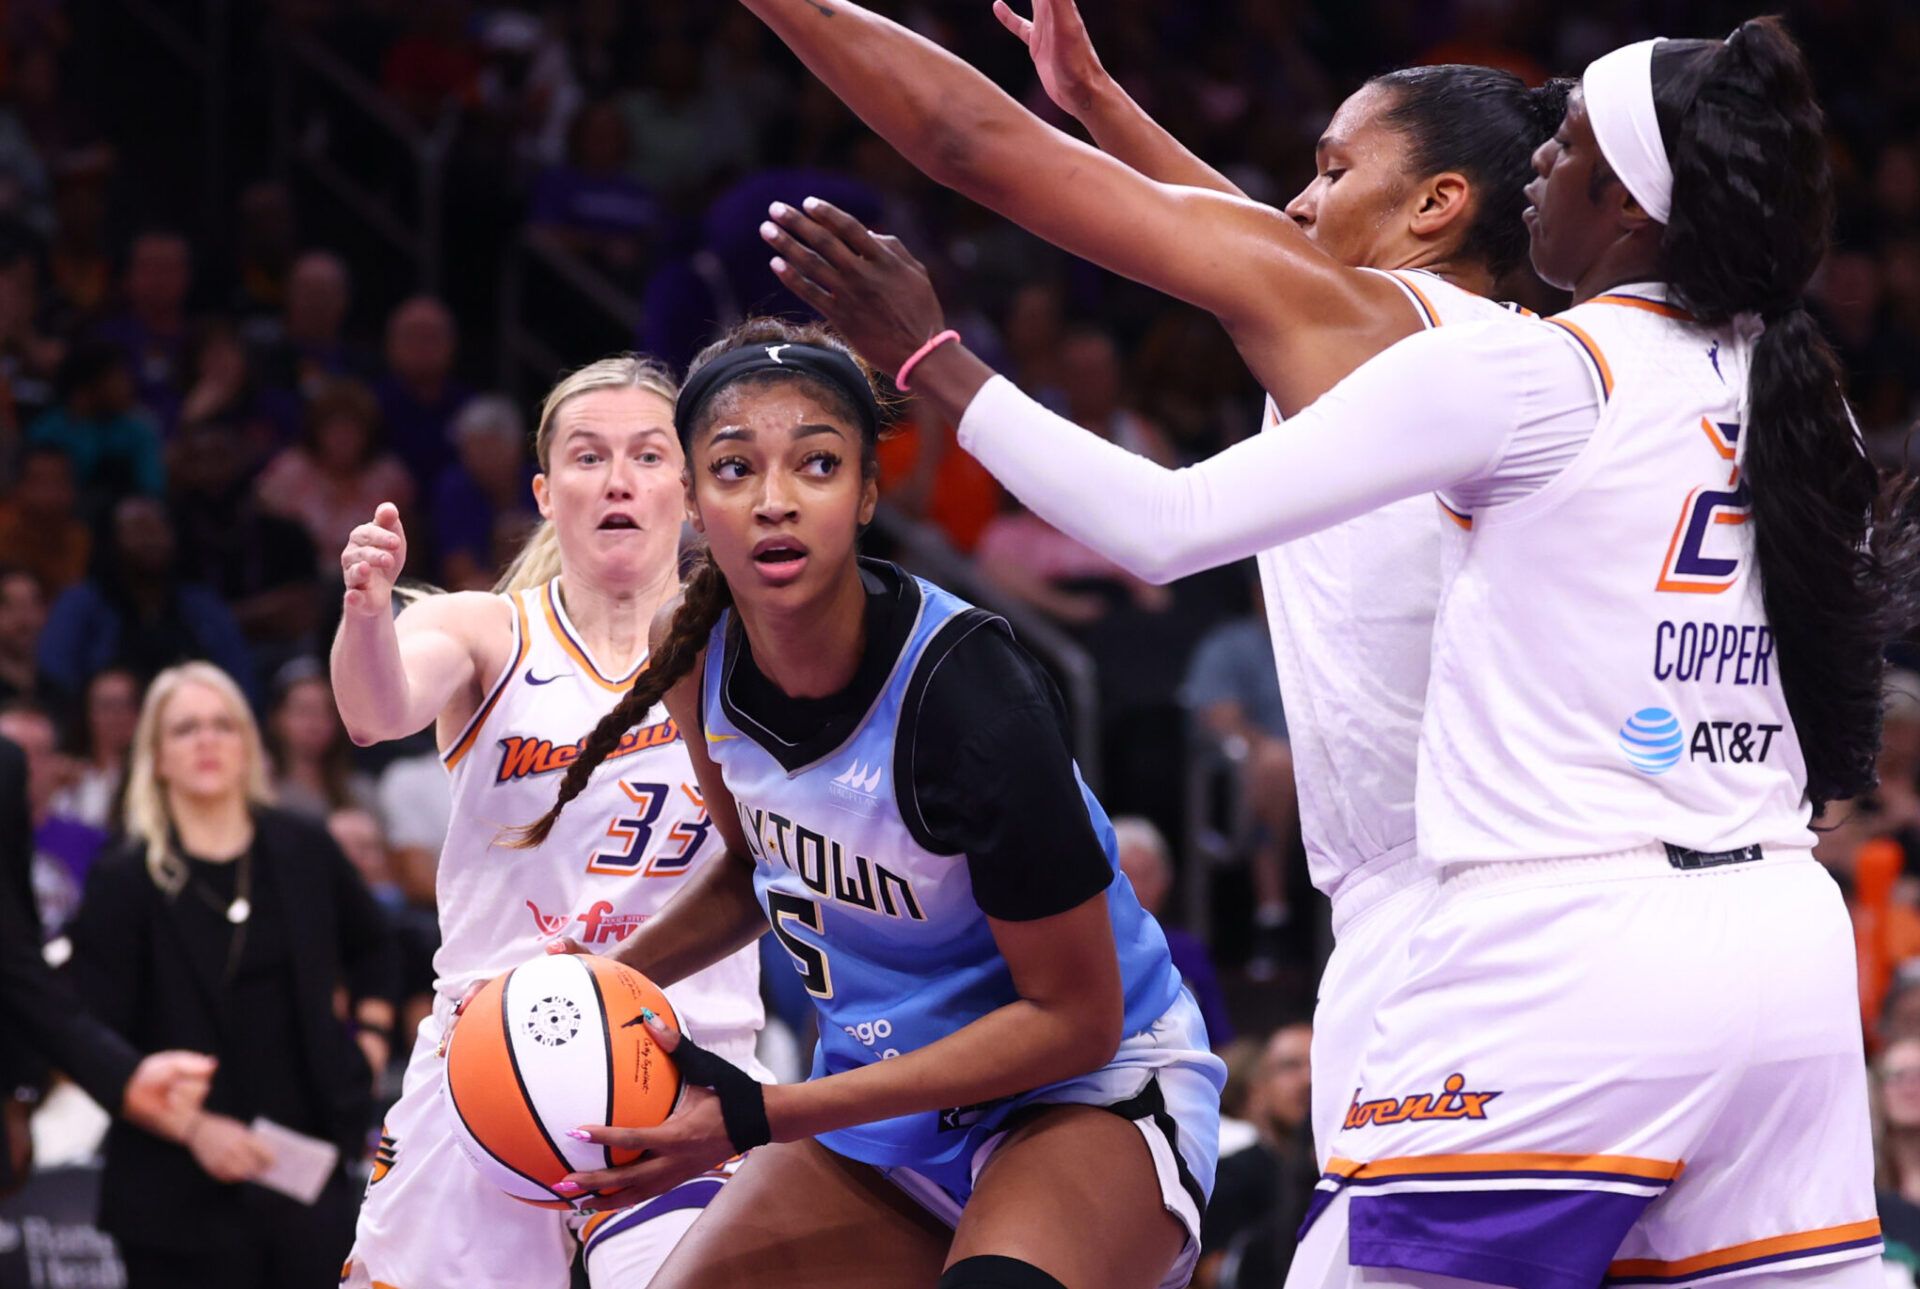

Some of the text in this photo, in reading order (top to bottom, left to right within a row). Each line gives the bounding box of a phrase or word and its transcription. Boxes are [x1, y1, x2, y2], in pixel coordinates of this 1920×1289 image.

[1655, 416, 1754, 595] 2
[1654, 620, 1774, 686] COPPER
[1690, 721, 1783, 764] AT&T
[586, 780, 712, 878] 33
[767, 887, 834, 1000] 5
